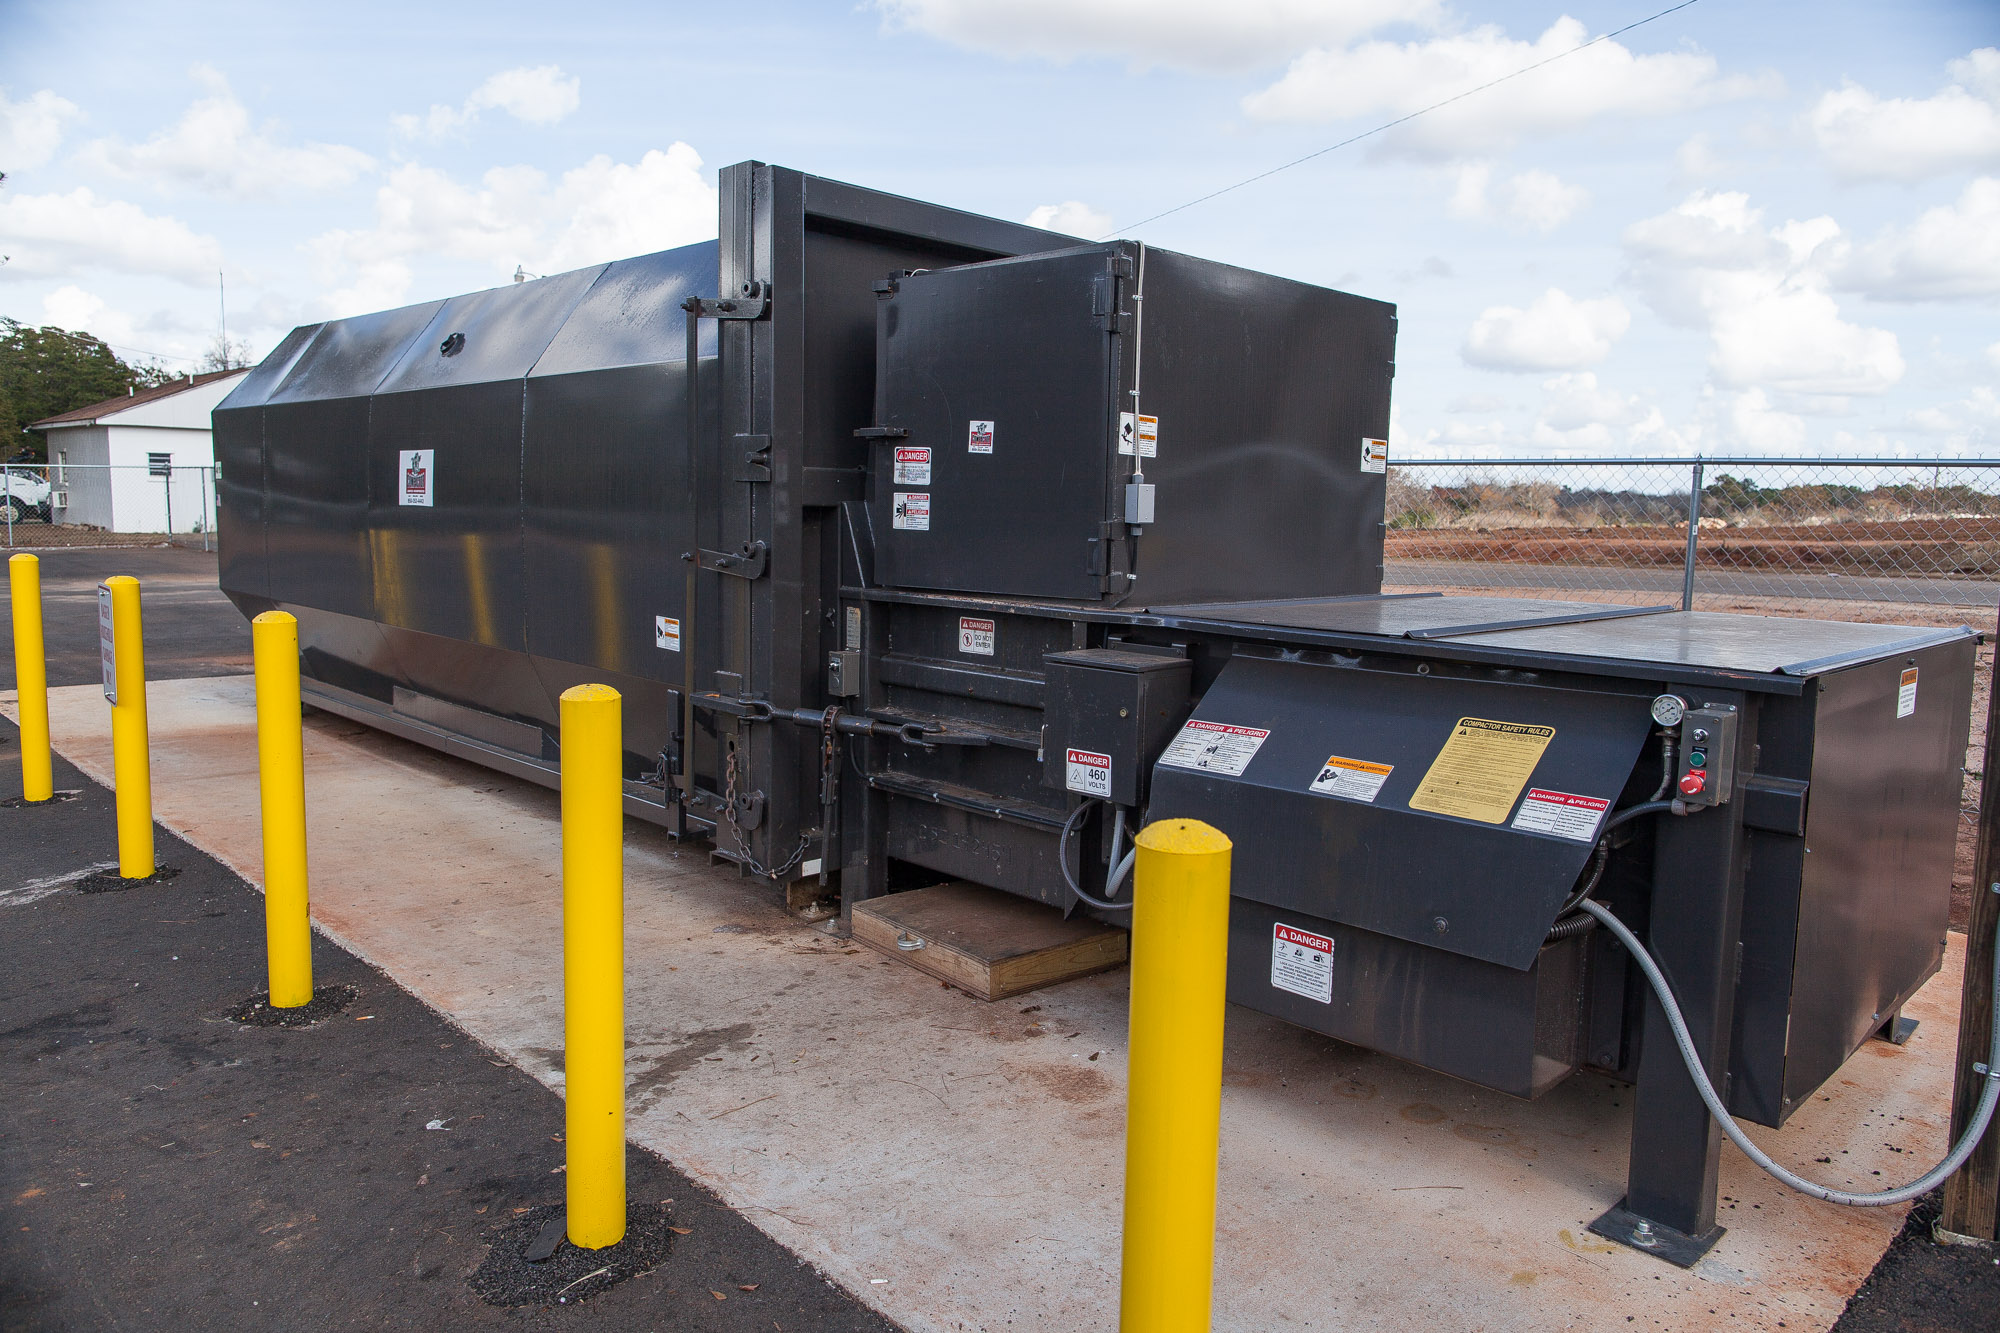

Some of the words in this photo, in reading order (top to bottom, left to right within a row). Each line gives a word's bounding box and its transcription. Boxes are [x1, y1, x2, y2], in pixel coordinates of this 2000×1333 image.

[904, 451, 928, 461] DANGER
[968, 621, 992, 630] DANGER
[975, 641, 991, 649] ENTER
[1195, 723, 1225, 732] DANGER
[1233, 728, 1266, 737] PELIGRO
[1463, 719, 1502, 731] COMPACTOR
[1501, 723, 1528, 734] SAFETY
[1526, 726, 1551, 736] RULES
[1078, 754, 1108, 767] DANGER
[1334, 760, 1359, 768] WARNING
[1088, 768, 1106, 782] 460
[1088, 781, 1106, 790] VOLTS
[1536, 793, 1566, 802] DANGER
[1574, 799, 1606, 809] PELIGRO
[1290, 932, 1329, 950] DANGER
